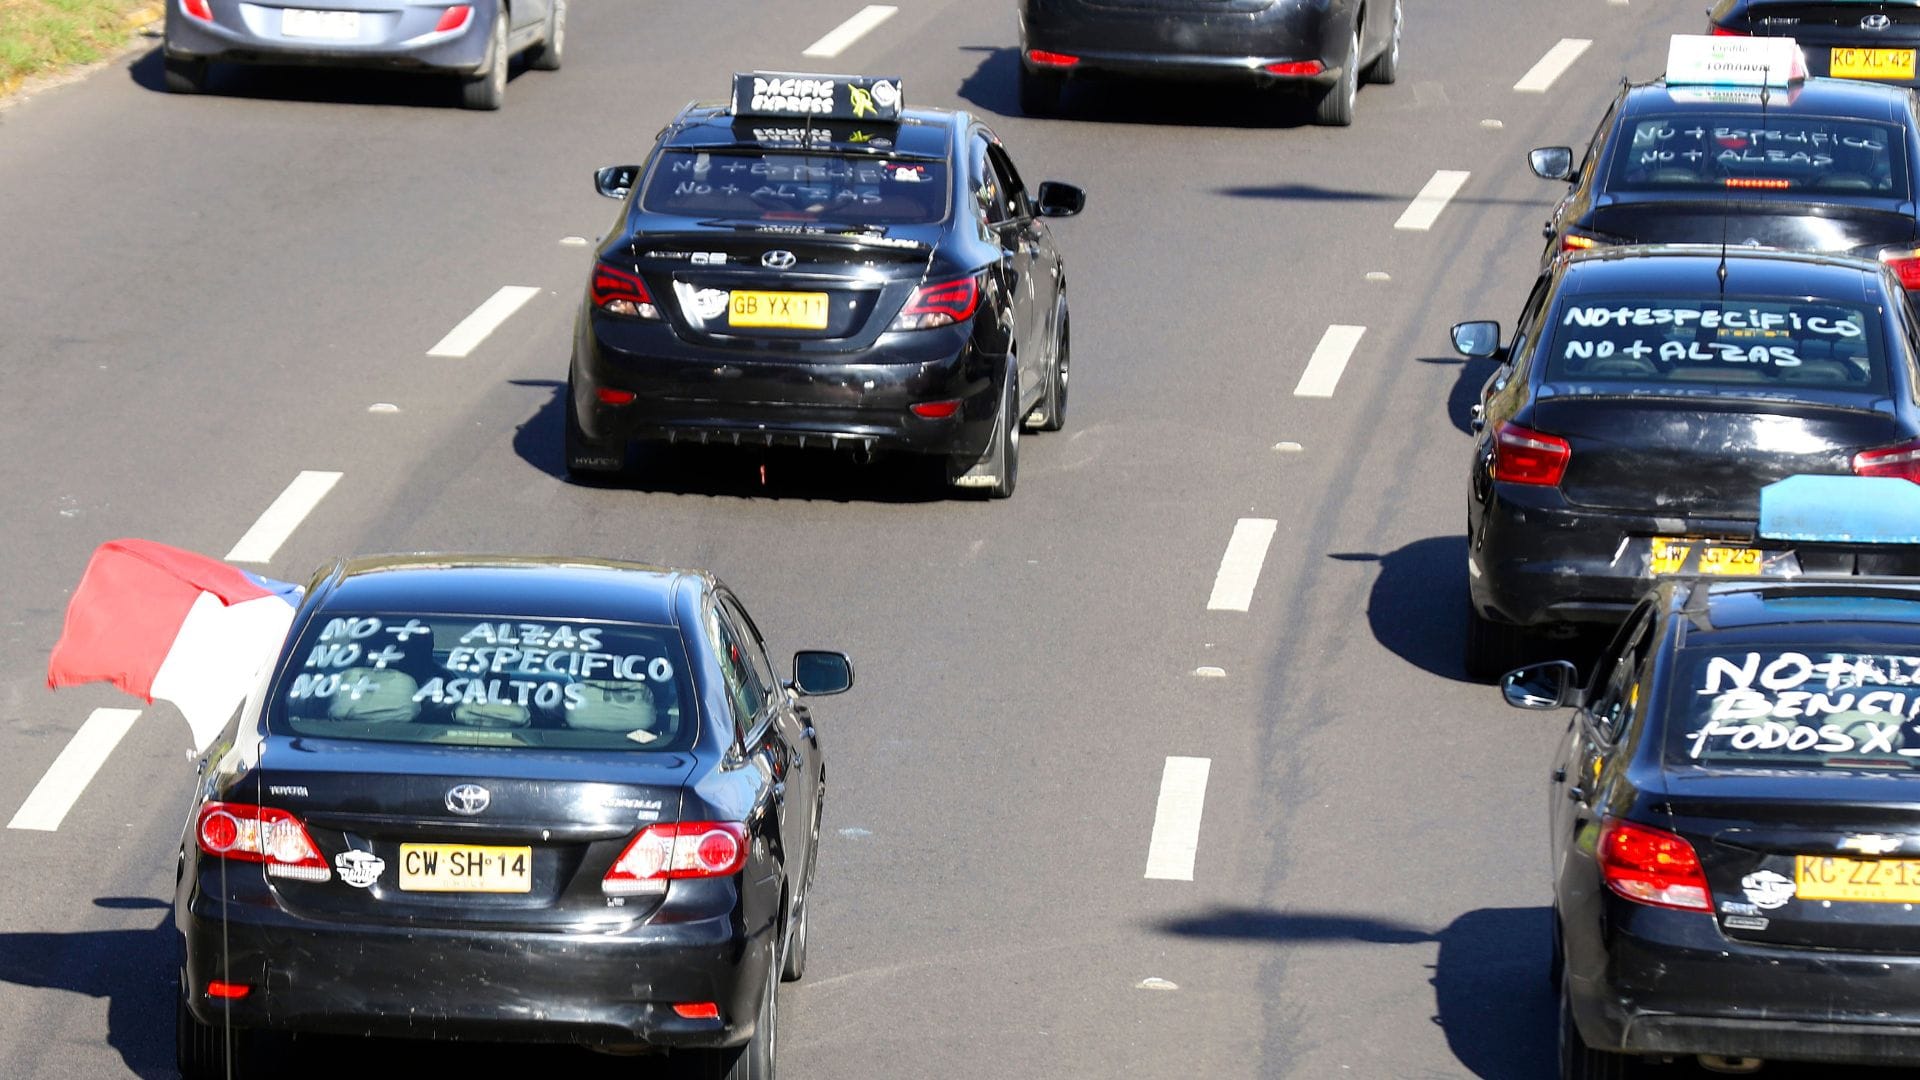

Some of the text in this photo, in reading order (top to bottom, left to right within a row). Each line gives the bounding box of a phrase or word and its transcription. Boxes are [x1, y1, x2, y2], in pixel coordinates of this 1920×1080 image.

[1834, 49, 1912, 67] KC XL 42
[753, 77, 834, 98] PACIFIC
[751, 95, 834, 114] EXPRESS
[1634, 126, 1676, 143] NO
[672, 160, 712, 173] NO
[1641, 150, 1675, 164] NO
[674, 181, 711, 196] NO
[734, 295, 758, 315] GB
[769, 296, 791, 316] YX
[802, 298, 822, 314] 11
[1563, 340, 1615, 360] NO
[1659, 342, 1802, 367] ALZAS
[320, 617, 603, 651] NO + ALZAS
[305, 643, 674, 682] NO + ESPECIFICO
[290, 673, 341, 699] NO
[411, 676, 588, 711] ASALTOS
[1860, 723, 1900, 754] X
[405, 850, 439, 877] CW
[449, 852, 485, 877] SH
[497, 852, 527, 877] 14
[1801, 857, 1836, 883] KC
[1847, 860, 1882, 886] ZZ
